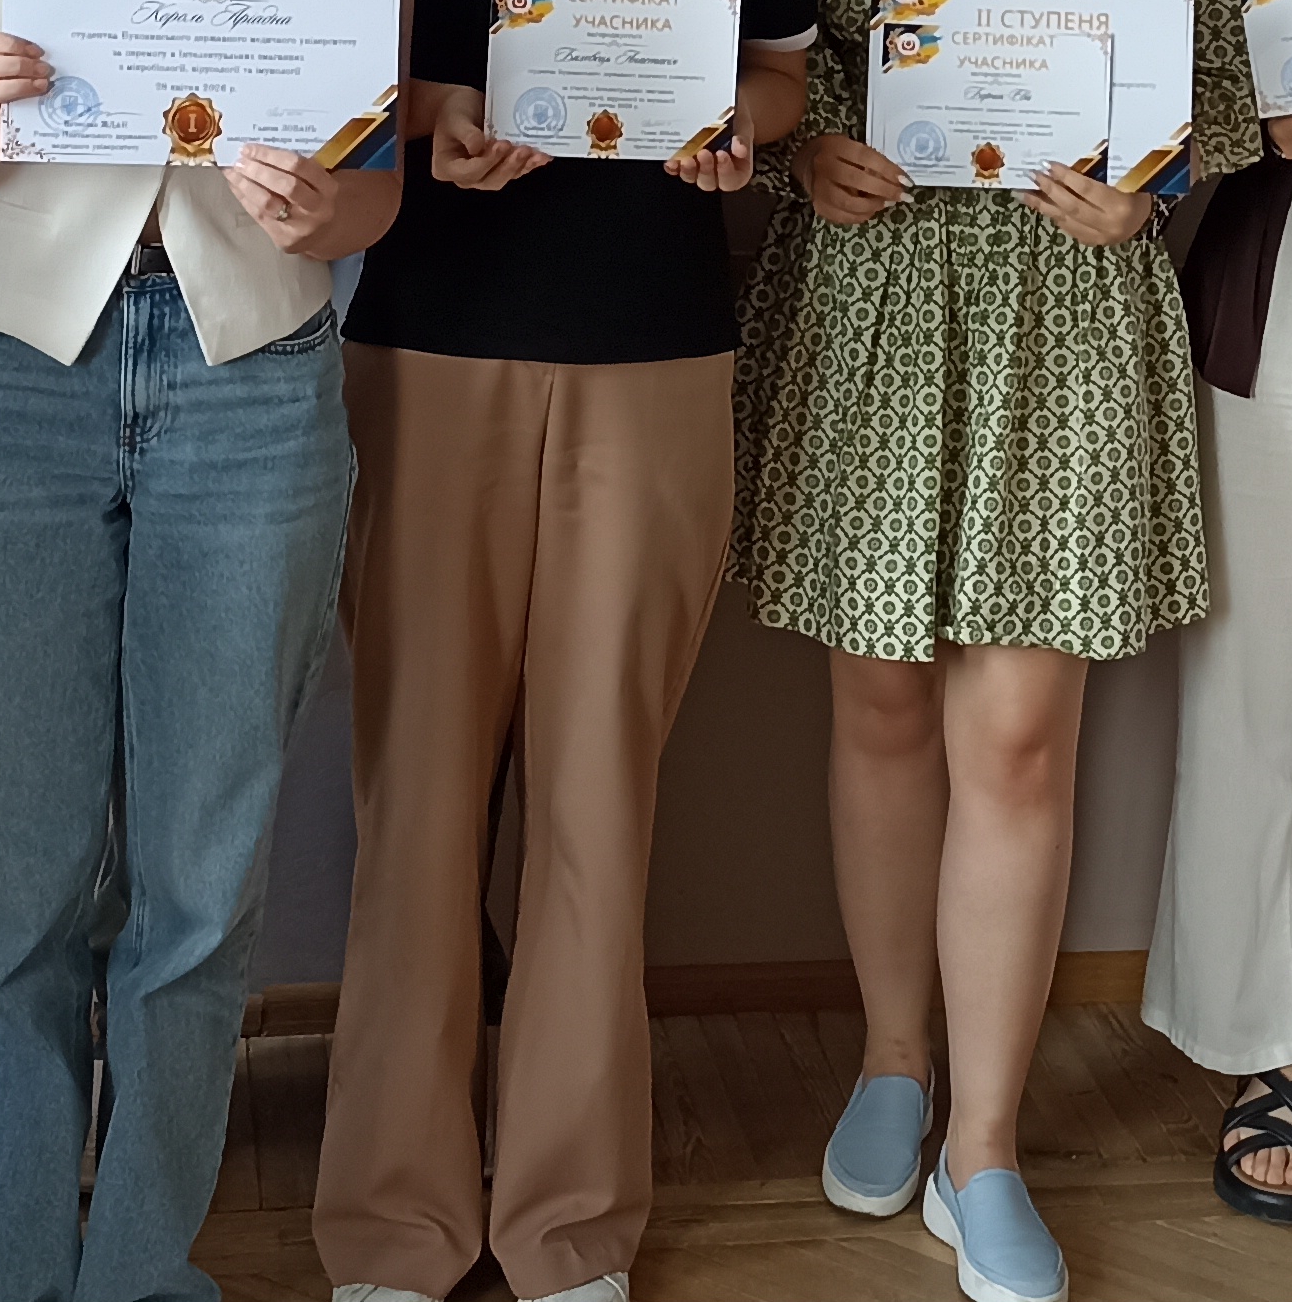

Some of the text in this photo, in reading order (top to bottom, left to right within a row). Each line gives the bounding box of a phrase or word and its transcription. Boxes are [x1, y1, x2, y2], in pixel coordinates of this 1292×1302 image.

[572, 14, 672, 32] УЧАСНИКА
[1000, 9, 1110, 32] СТУПЕНЯ
[951, 30, 1059, 49] СЕРТИФІКАТ
[957, 54, 1050, 71] УЧАСНИКА
